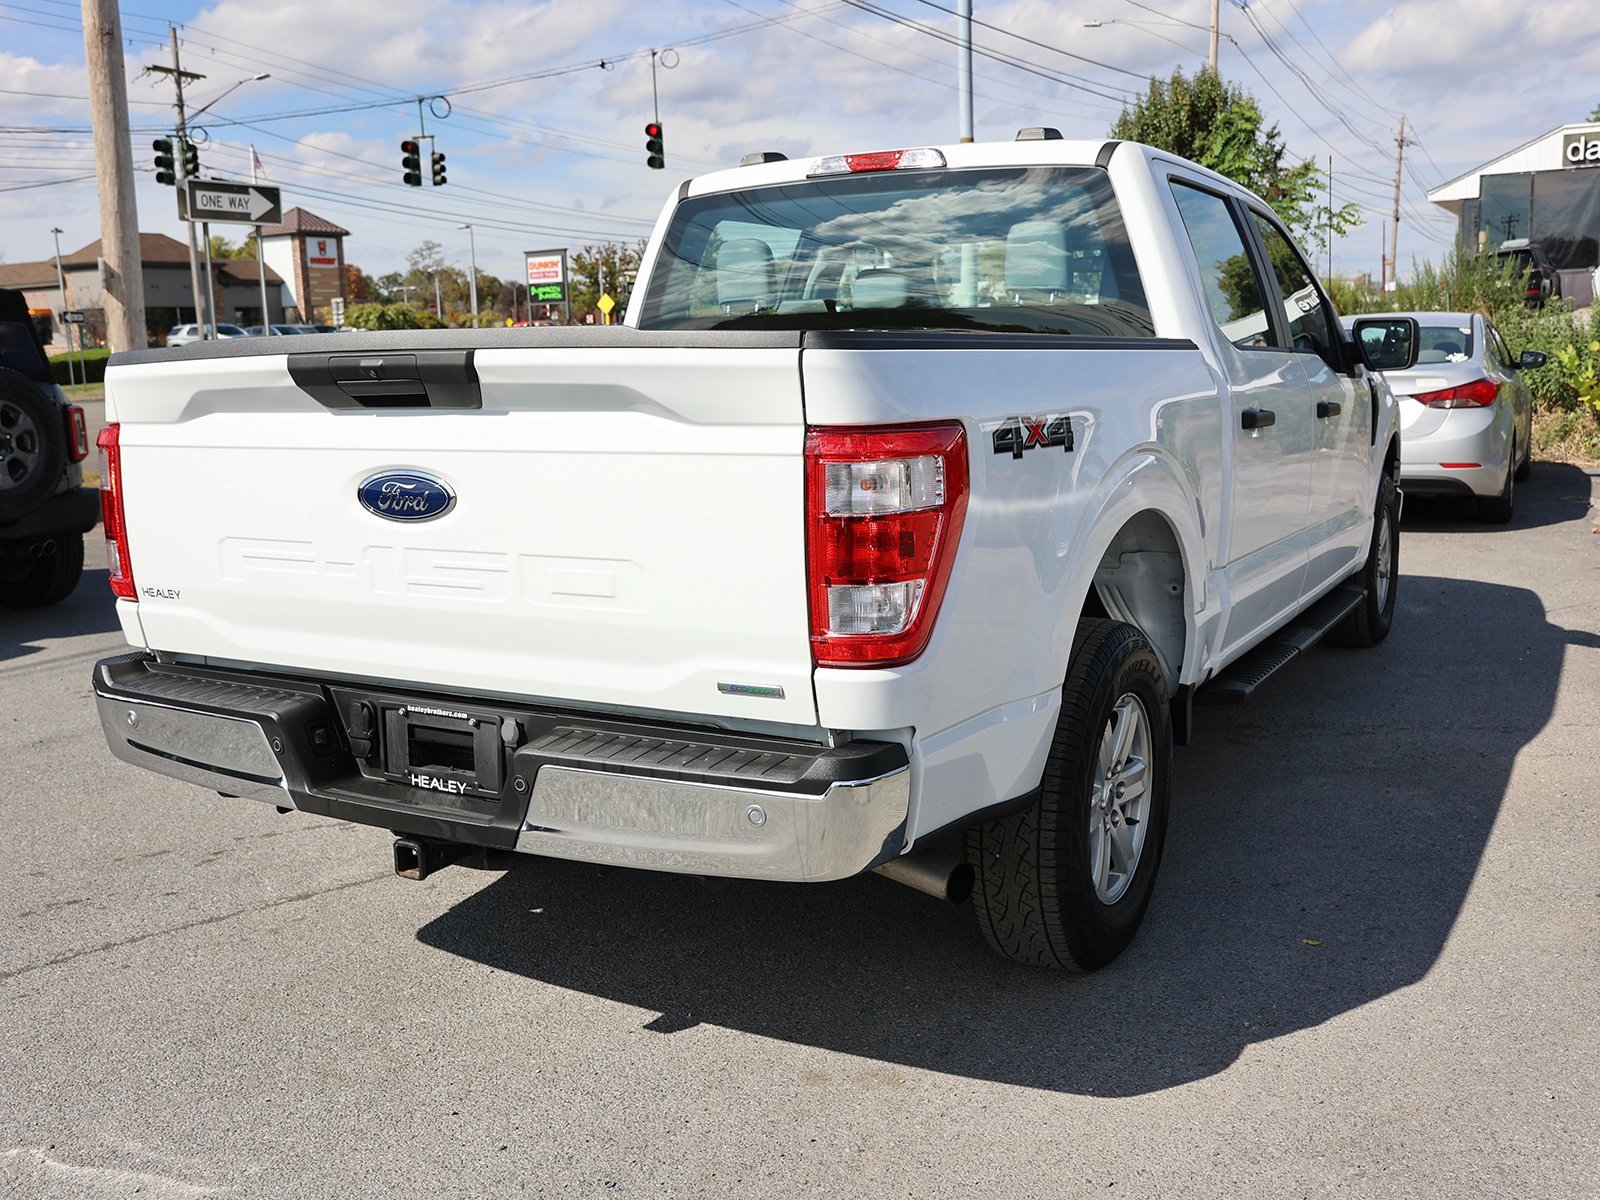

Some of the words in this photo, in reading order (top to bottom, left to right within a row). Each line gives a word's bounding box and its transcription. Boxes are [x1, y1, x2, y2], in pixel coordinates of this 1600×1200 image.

[1566, 135, 1600, 162] da
[200, 193, 223, 209] ONE
[228, 196, 251, 211] WAY
[377, 481, 430, 512] Ford
[141, 586, 181, 600] HEALEY
[407, 704, 468, 719] healeybrothers.com
[411, 773, 467, 794] HEALEY
